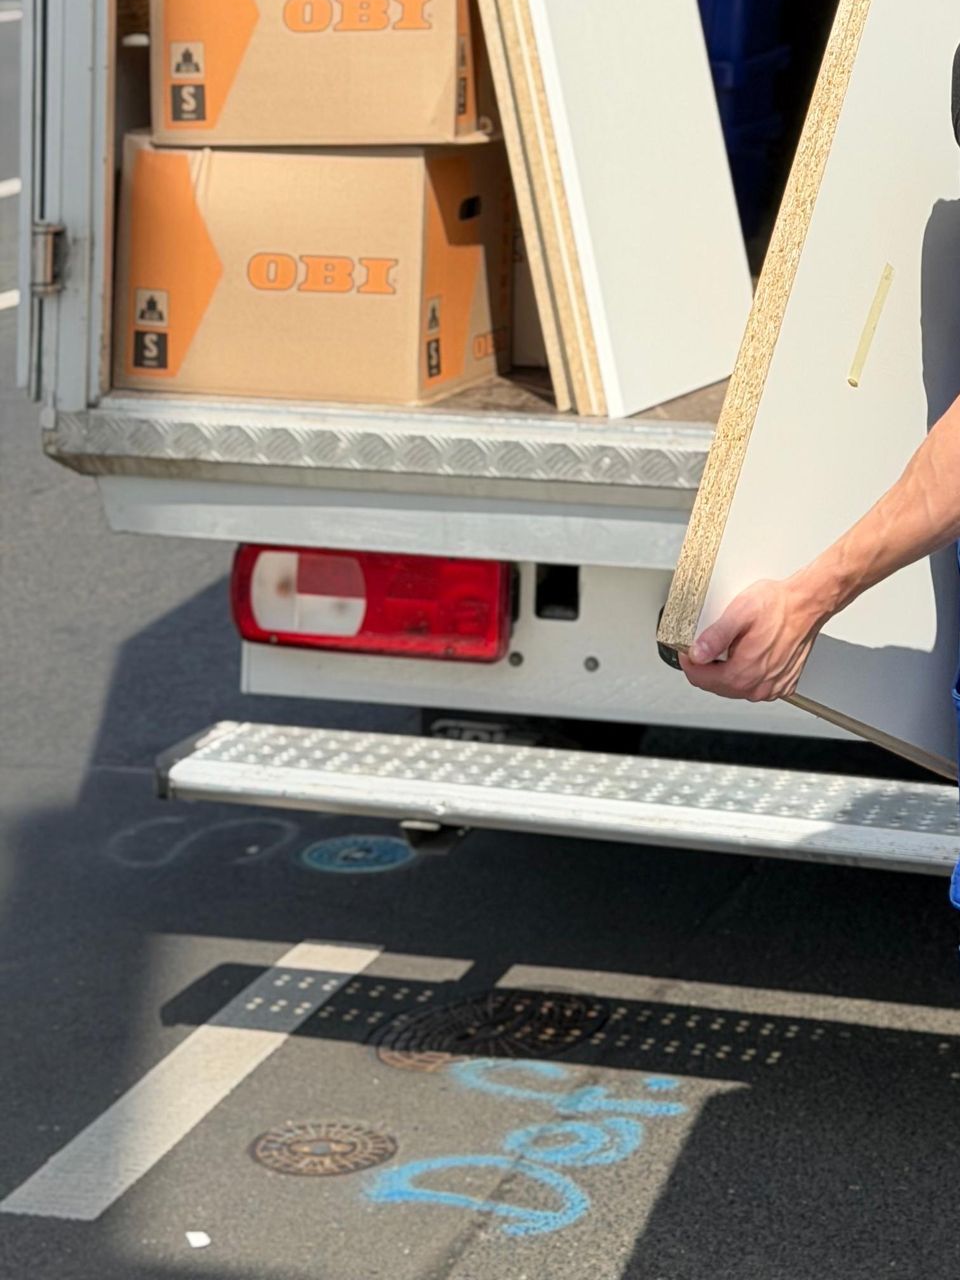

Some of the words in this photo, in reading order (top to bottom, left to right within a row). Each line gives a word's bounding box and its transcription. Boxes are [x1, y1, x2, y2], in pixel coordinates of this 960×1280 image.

[181, 86, 197, 112] S
[247, 252, 399, 295] OBI
[143, 333, 159, 358] S
